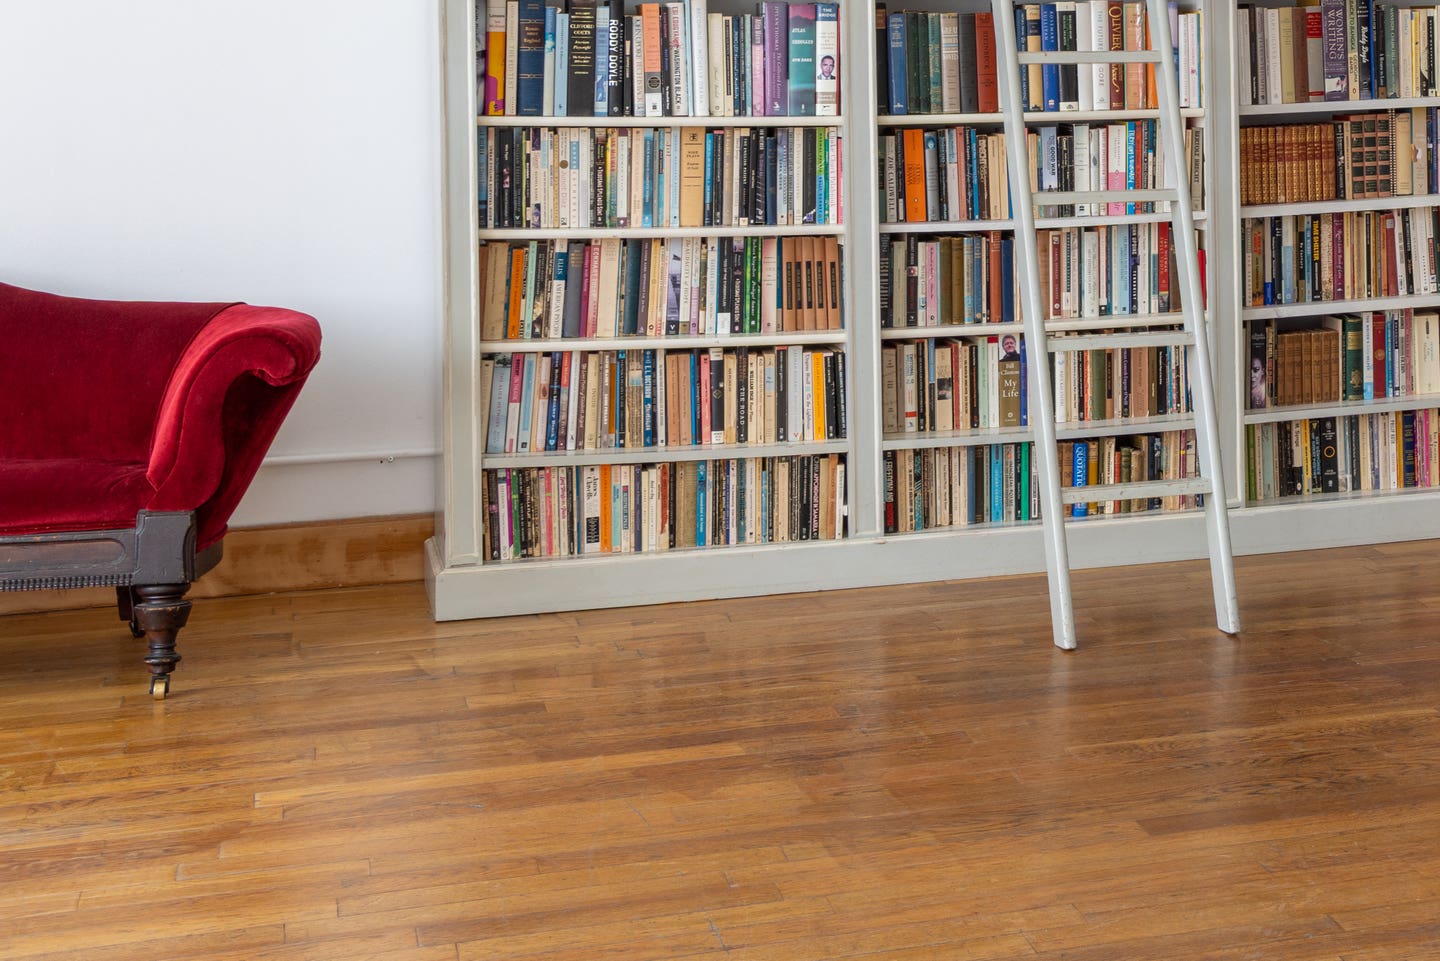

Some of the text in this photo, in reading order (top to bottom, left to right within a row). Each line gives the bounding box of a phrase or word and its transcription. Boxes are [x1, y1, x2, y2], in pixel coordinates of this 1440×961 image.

[608, 20, 618, 86] RODDY DOYLE
[1108, 6, 1122, 50] OLIVIER
[1328, 8, 1337, 60] WRITING
[1336, 9, 1344, 60] WOMEN'S
